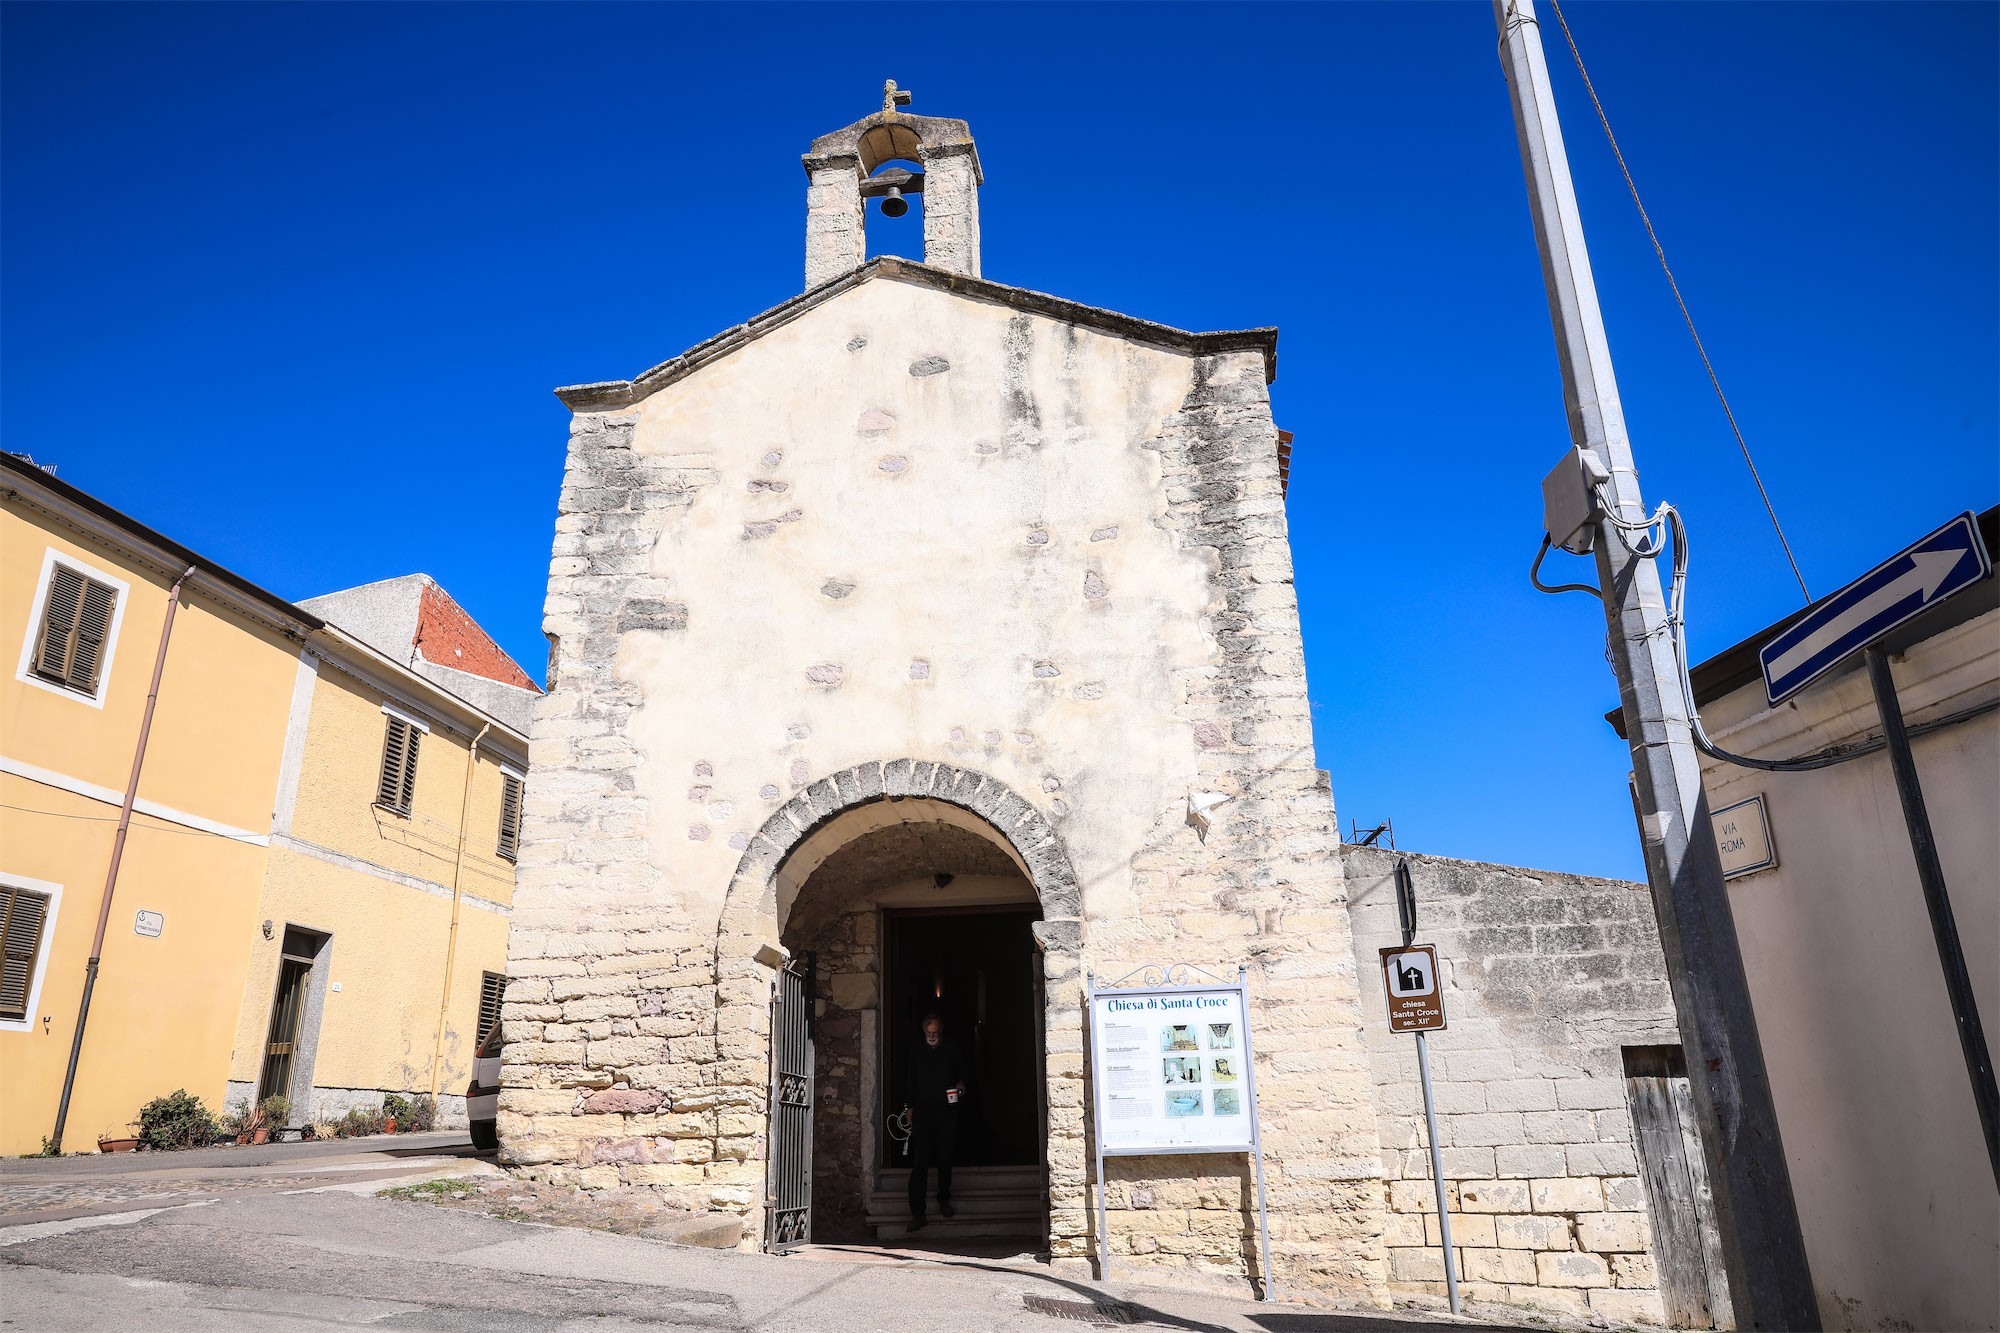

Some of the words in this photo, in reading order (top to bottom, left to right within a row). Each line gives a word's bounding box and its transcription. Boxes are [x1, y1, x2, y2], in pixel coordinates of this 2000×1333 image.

[1722, 822, 1737, 835] VIA
[1721, 837, 1746, 854] ROMA
[1108, 999, 1144, 1012] Chiesa
[1147, 998, 1158, 1010] di
[1161, 997, 1193, 1010] Santa
[1196, 996, 1228, 1009] Croce
